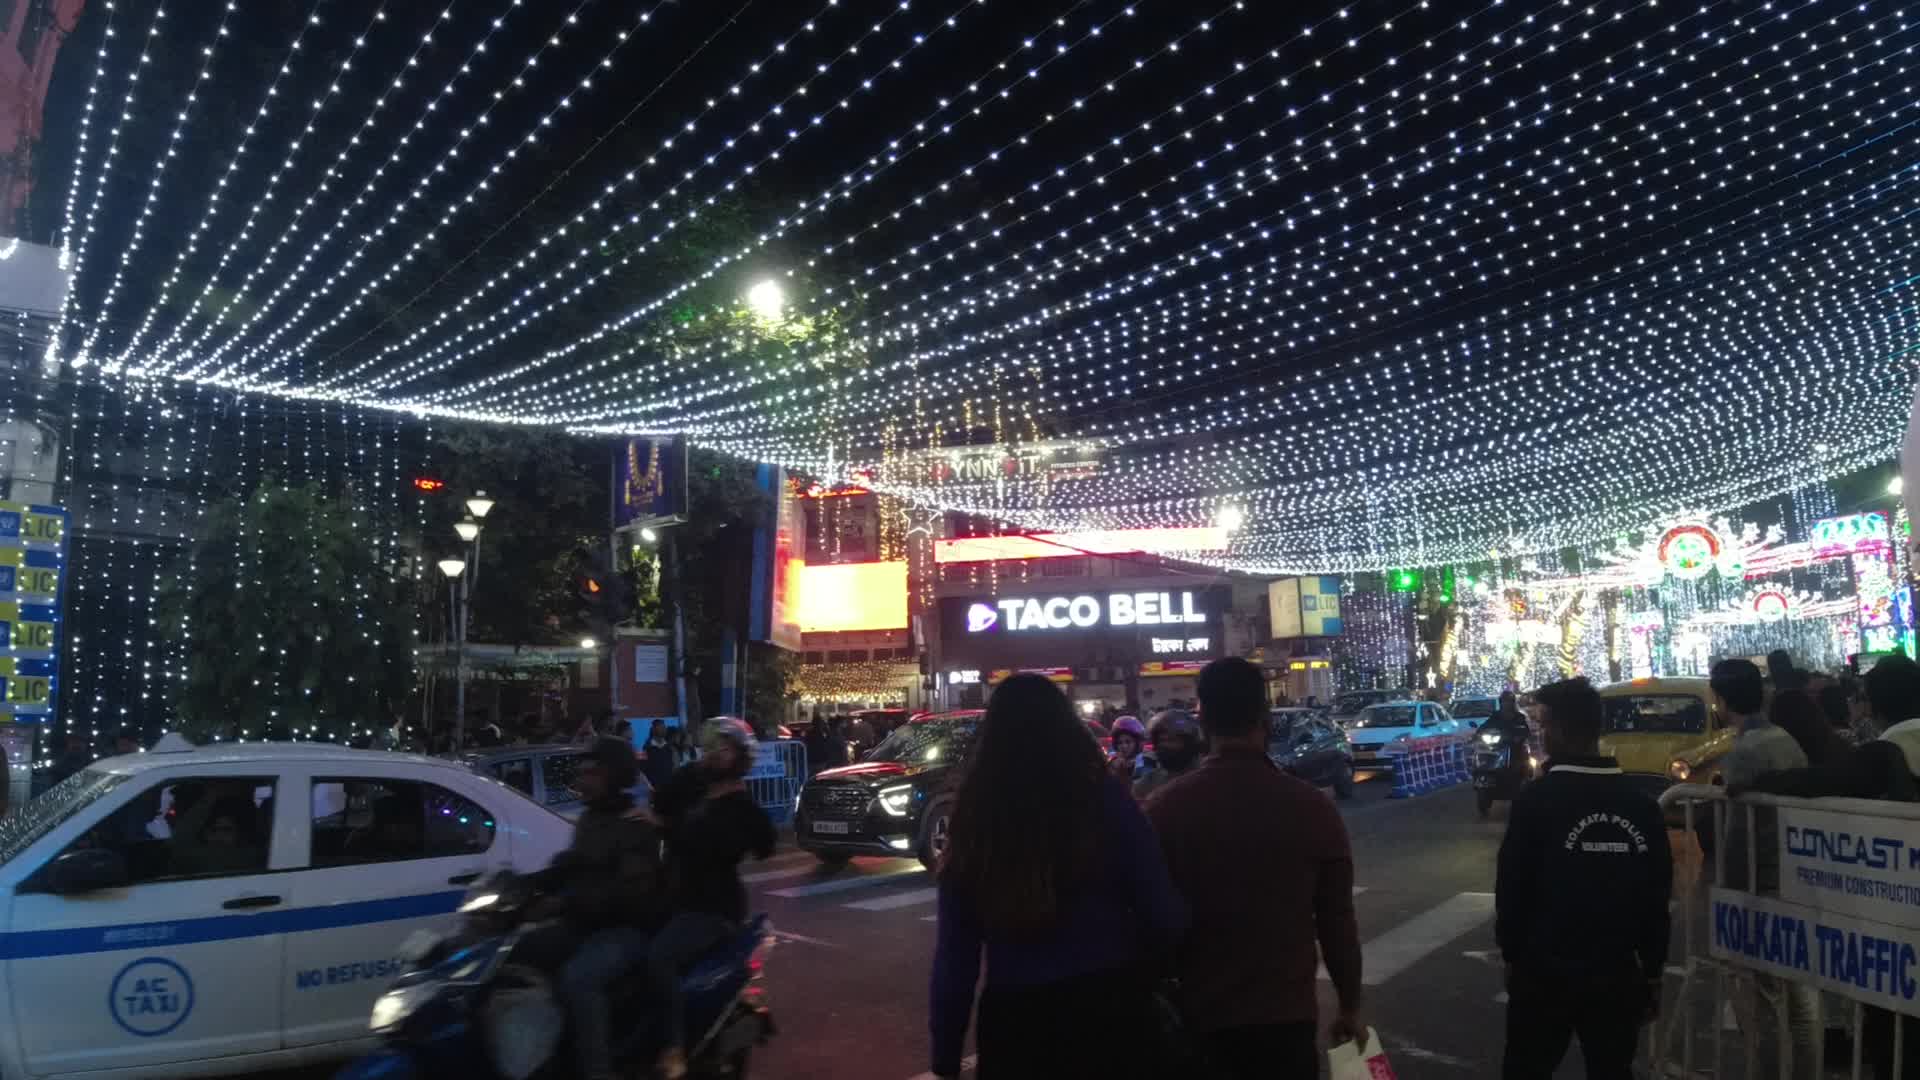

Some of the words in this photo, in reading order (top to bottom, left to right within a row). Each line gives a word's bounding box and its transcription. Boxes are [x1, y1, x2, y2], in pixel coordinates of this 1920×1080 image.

[24, 516, 58, 539] LIC
[19, 570, 53, 592] LIC
[998, 596, 1101, 631] TACO
[1108, 592, 1206, 626] BELL
[15, 624, 49, 646] LIC
[12, 679, 46, 701] LIC
[1565, 812, 1609, 850] KOLKATA
[1611, 815, 1648, 853] POLICE
[1786, 826, 1904, 871] CONCAST
[1797, 866, 1843, 891] PREMIUM
[1712, 900, 1809, 971] KOLKATA
[1815, 923, 1917, 1000] TRAFFIC
[134, 976, 168, 993] AC
[296, 969, 322, 992] NO
[123, 992, 178, 1016] TAXI
